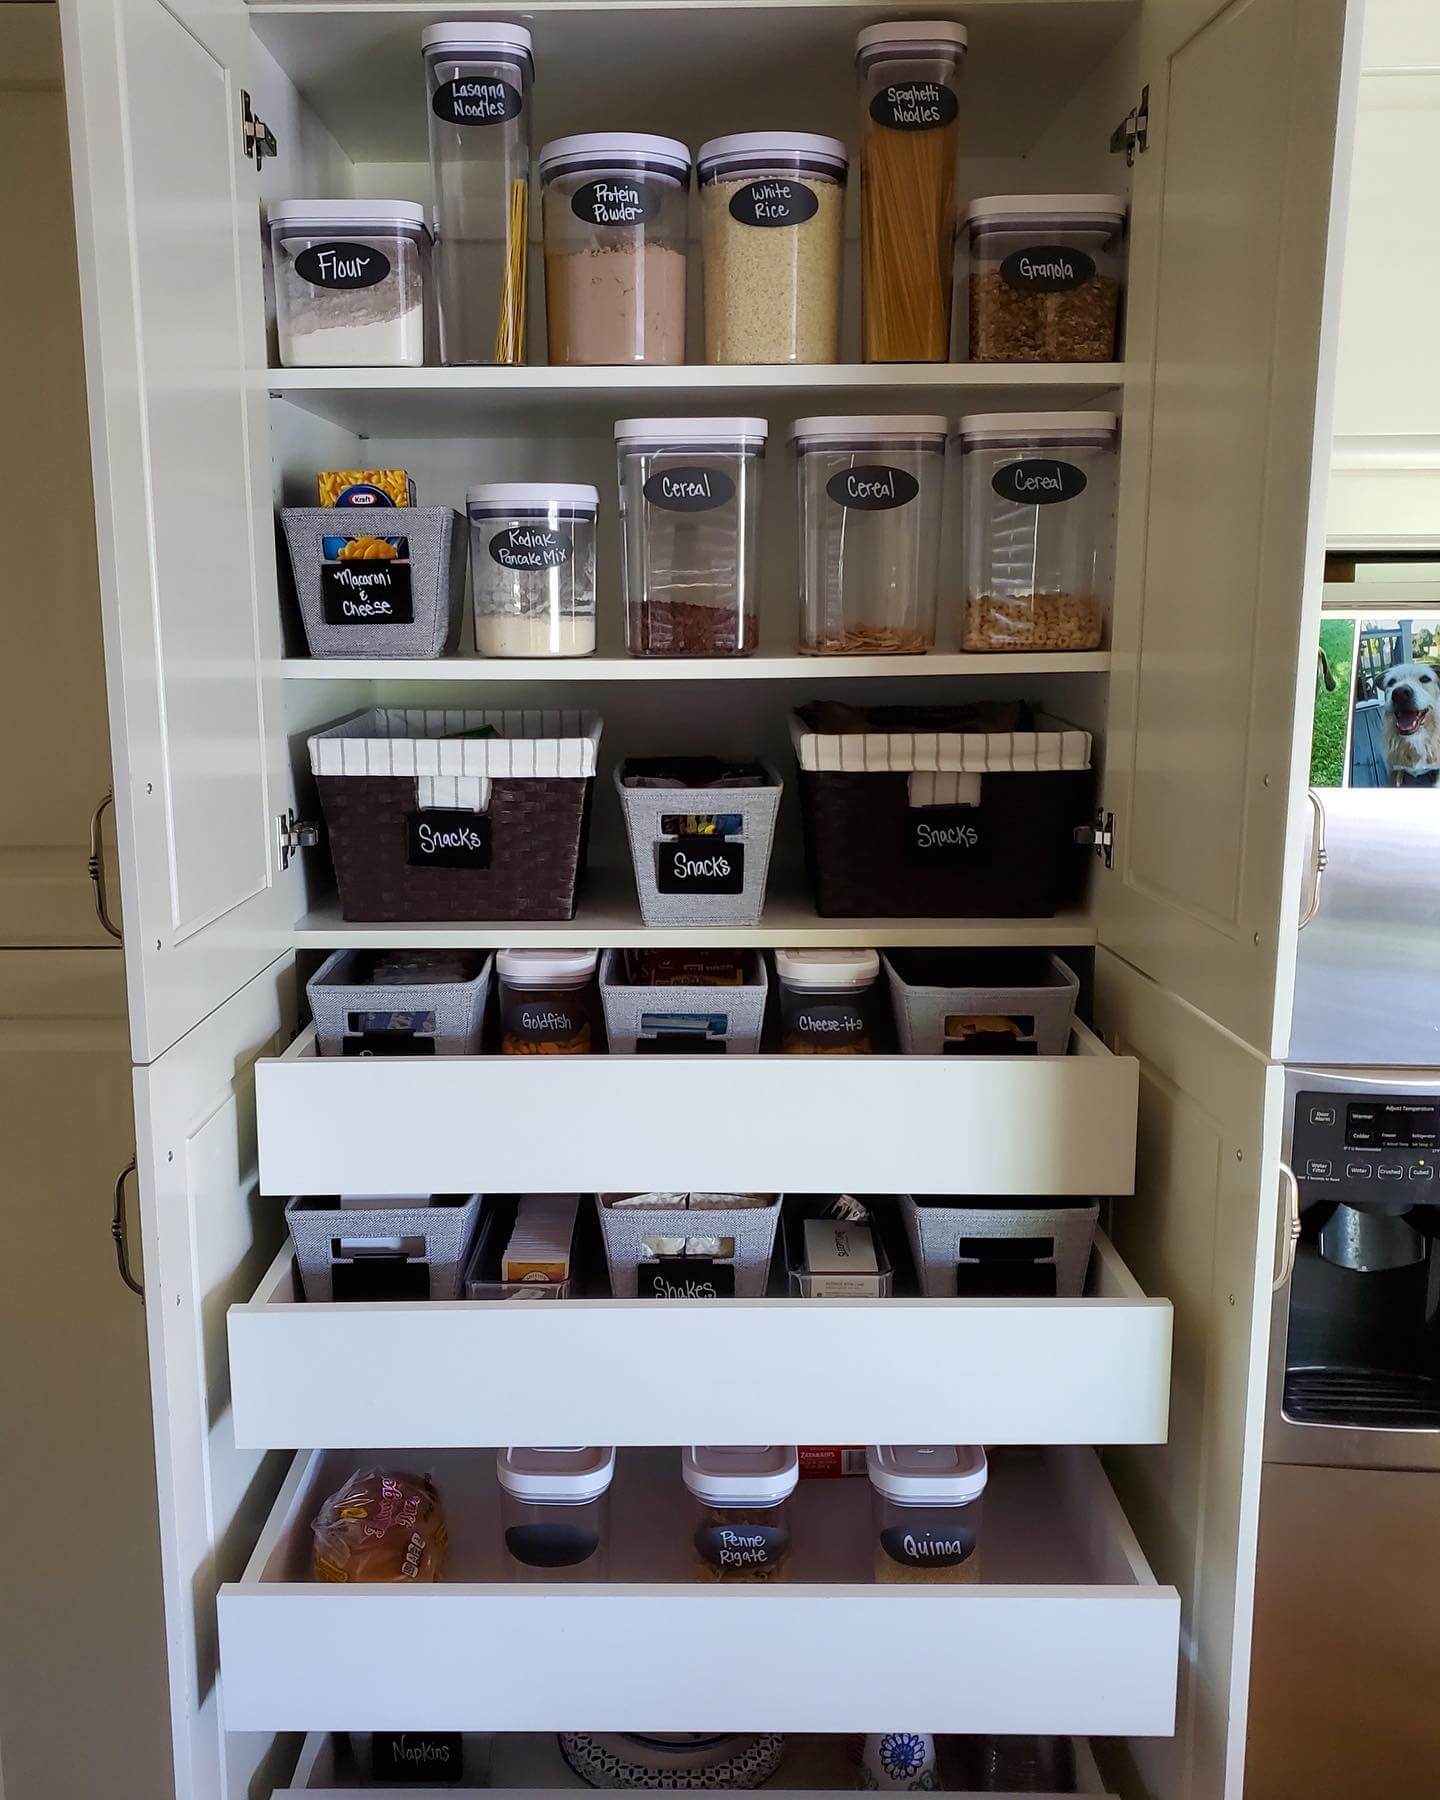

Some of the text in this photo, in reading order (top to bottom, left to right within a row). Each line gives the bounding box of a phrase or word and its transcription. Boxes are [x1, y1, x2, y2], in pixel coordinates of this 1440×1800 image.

[452, 82, 506, 102] Lasagna
[887, 86, 940, 108] Spaghetti
[453, 99, 506, 117] Noodles
[893, 106, 941, 123] Noodles
[593, 182, 640, 204] Protein
[751, 183, 793, 201] White
[593, 203, 643, 223] Powder
[754, 201, 790, 219] Rice
[317, 249, 371, 280] Flour
[1019, 256, 1075, 280] Granola
[661, 473, 711, 499] Cereal
[846, 471, 895, 499] Cereal
[1014, 469, 1063, 492] Cereal
[353, 494, 371, 504] Kraft
[508, 529, 557, 547] Kodiak
[498, 547, 567, 567] Pancake Mix
[333, 567, 392, 590] Macaroni
[342, 599, 393, 617] Cheese
[418, 823, 482, 852] Snacks
[916, 823, 979, 848] Snacks
[673, 851, 731, 879] Snacks
[521, 1011, 572, 1032] Goldfish
[653, 1276, 716, 1299] Shakes
[720, 1530, 766, 1549] Penne
[903, 1532, 962, 1559] Quinoa
[719, 1548, 768, 1567] Rigate
[392, 1734, 450, 1768] Napkins
